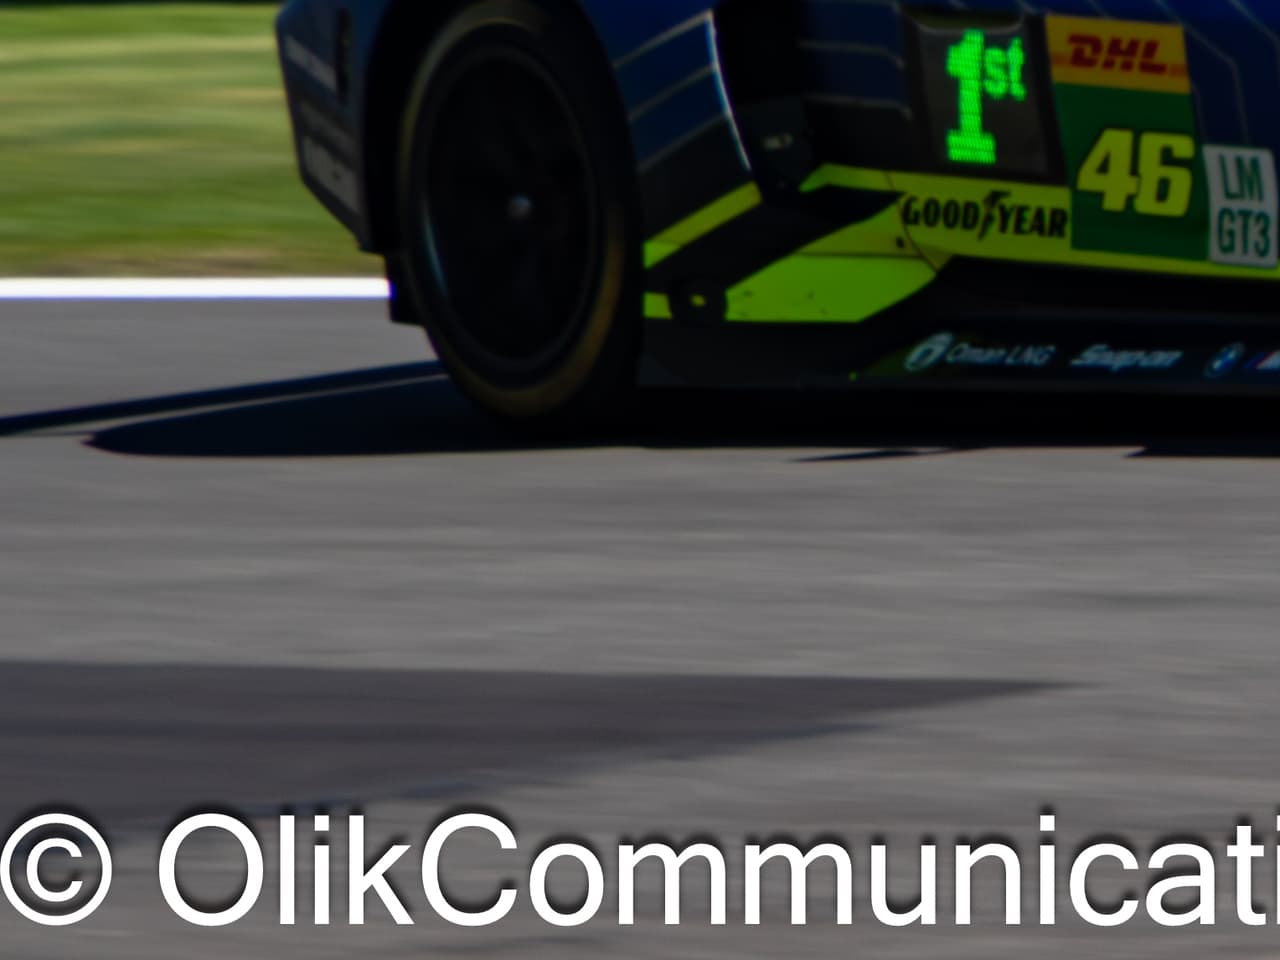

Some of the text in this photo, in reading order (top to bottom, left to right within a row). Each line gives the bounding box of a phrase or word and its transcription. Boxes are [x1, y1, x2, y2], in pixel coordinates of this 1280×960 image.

[1068, 34, 1169, 75] DHL
[944, 28, 1027, 165] 1st
[1075, 126, 1197, 218] 46
[1219, 152, 1264, 203] LM
[902, 190, 1069, 239] GOODYEAR
[1216, 208, 1271, 258] GT3
[946, 342, 1057, 368] Oman LNG
